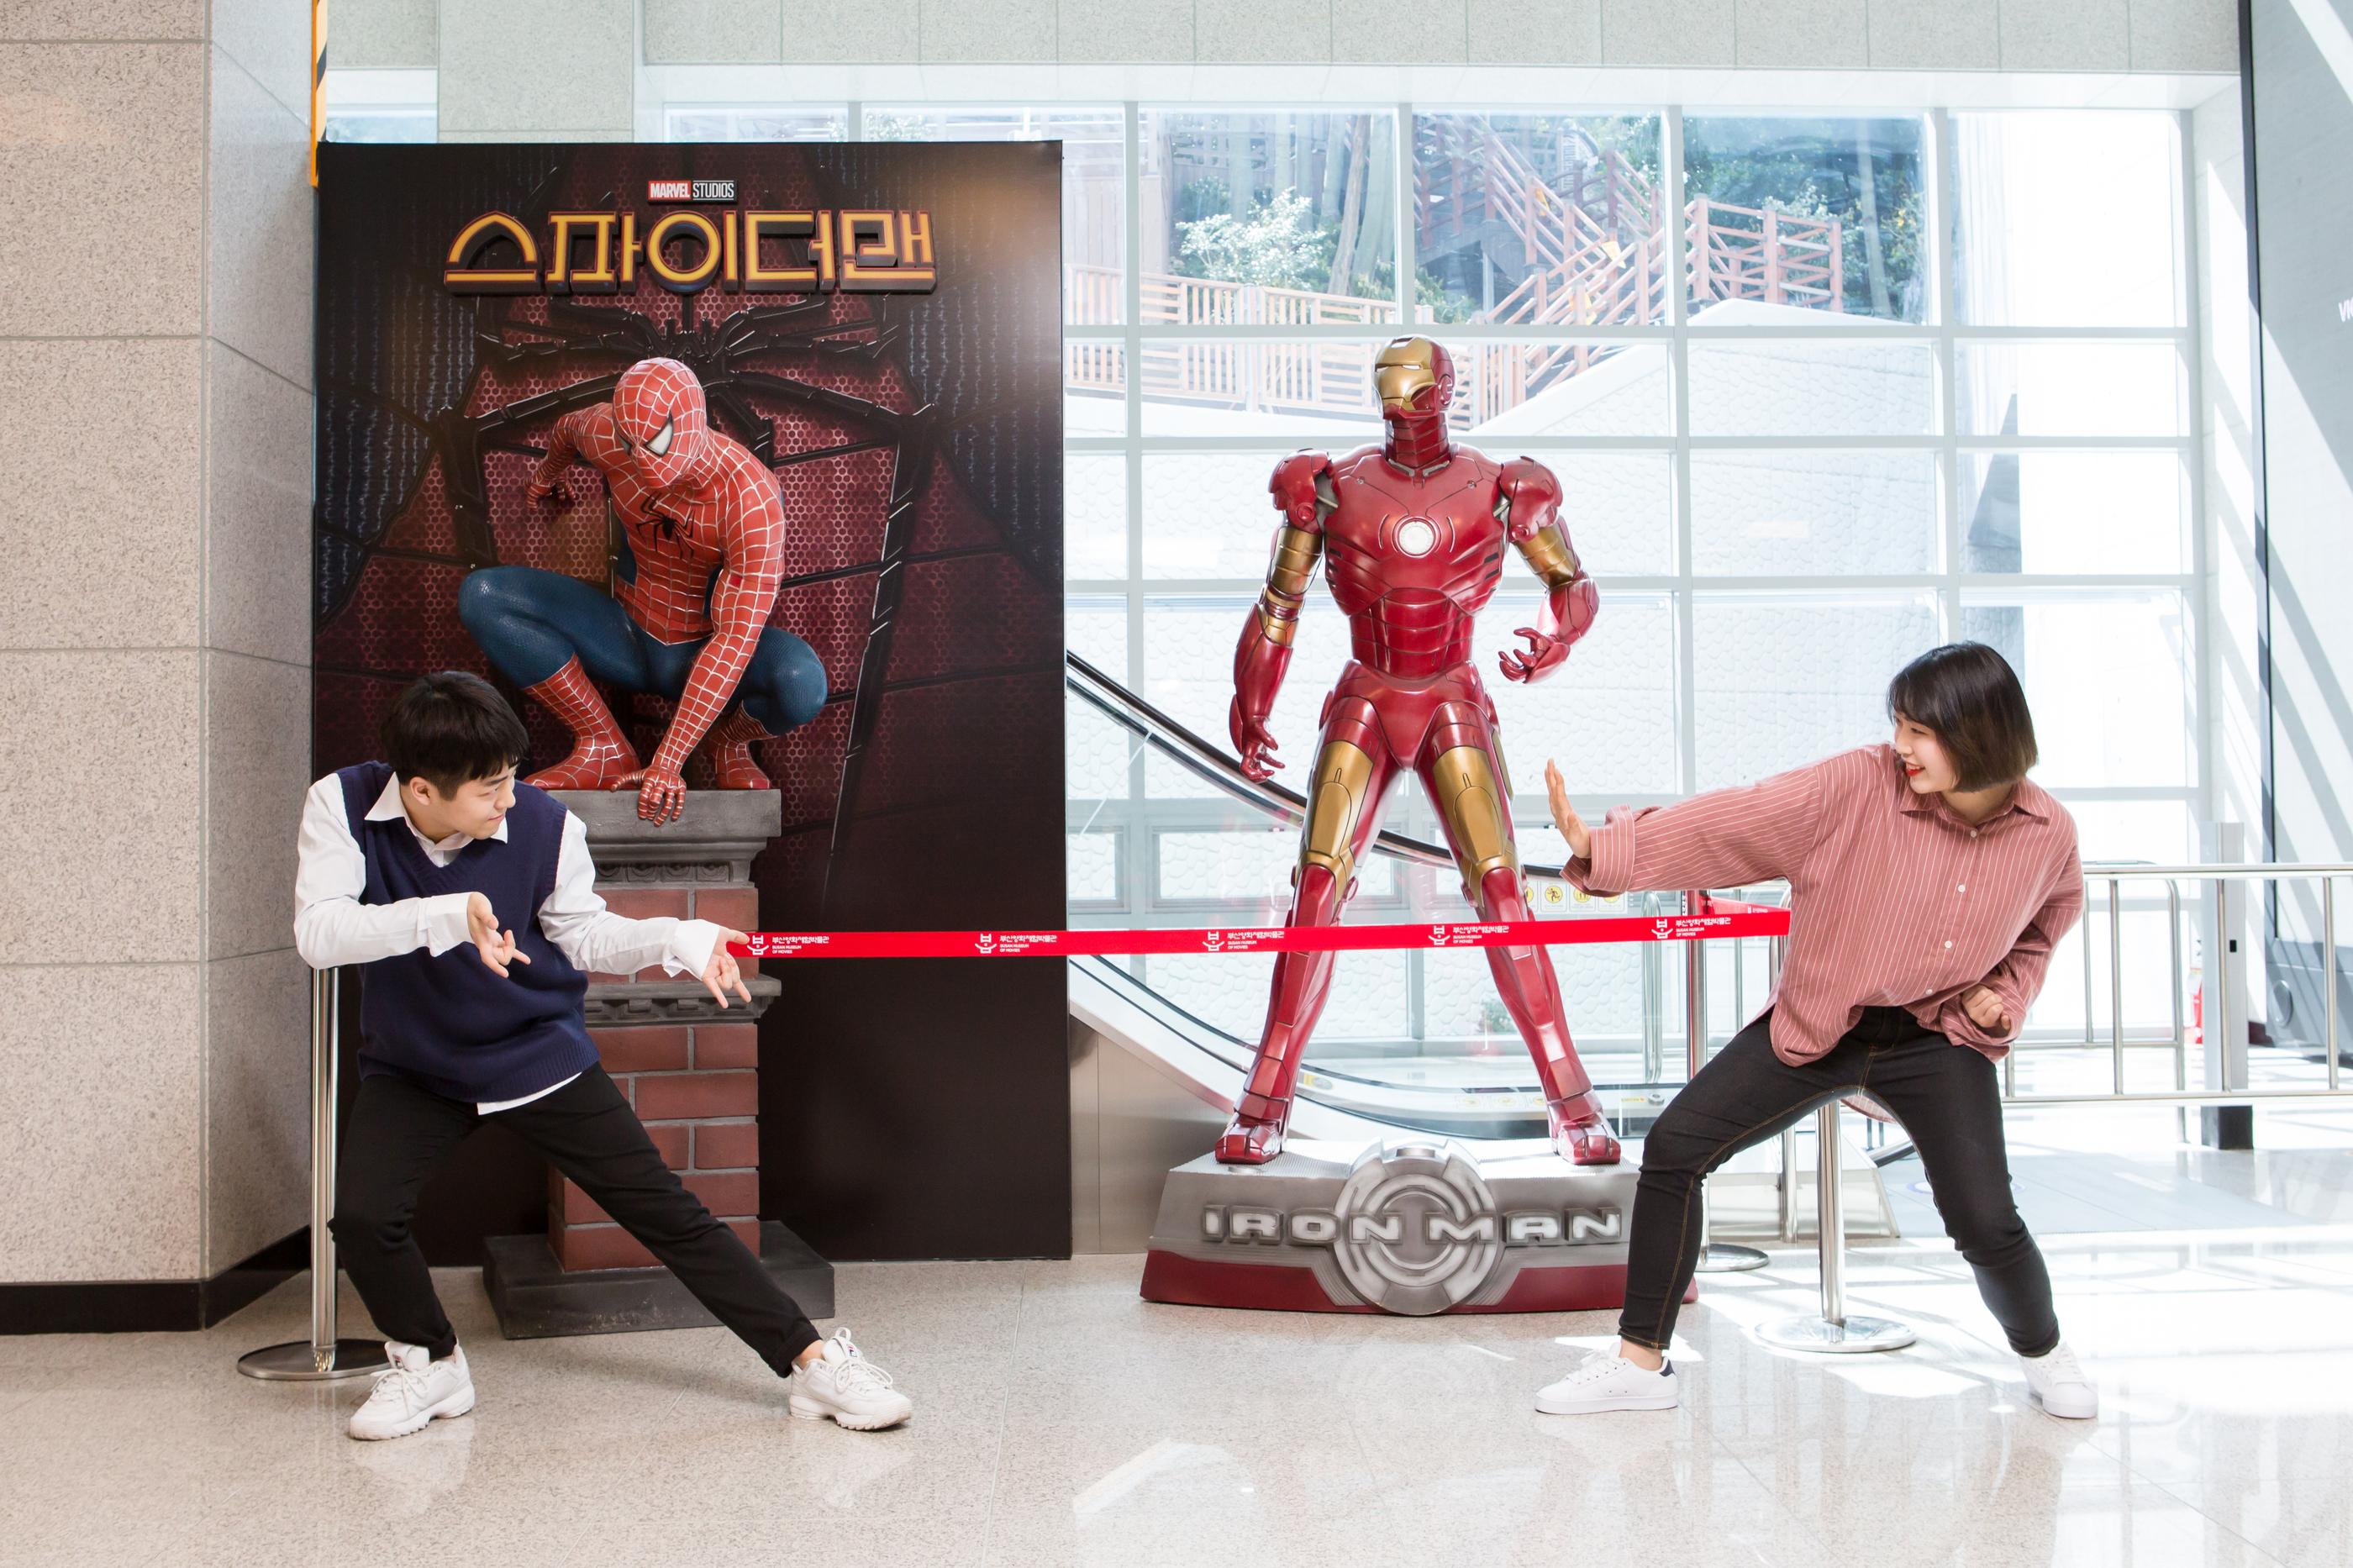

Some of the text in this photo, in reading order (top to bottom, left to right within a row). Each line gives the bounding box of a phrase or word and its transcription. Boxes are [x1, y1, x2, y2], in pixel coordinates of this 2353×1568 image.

[650, 182, 734, 198] MARVEL STUDIOS
[445, 210, 937, 293] 스파이더맨
[1203, 1206, 1622, 1245] IRON MAN
